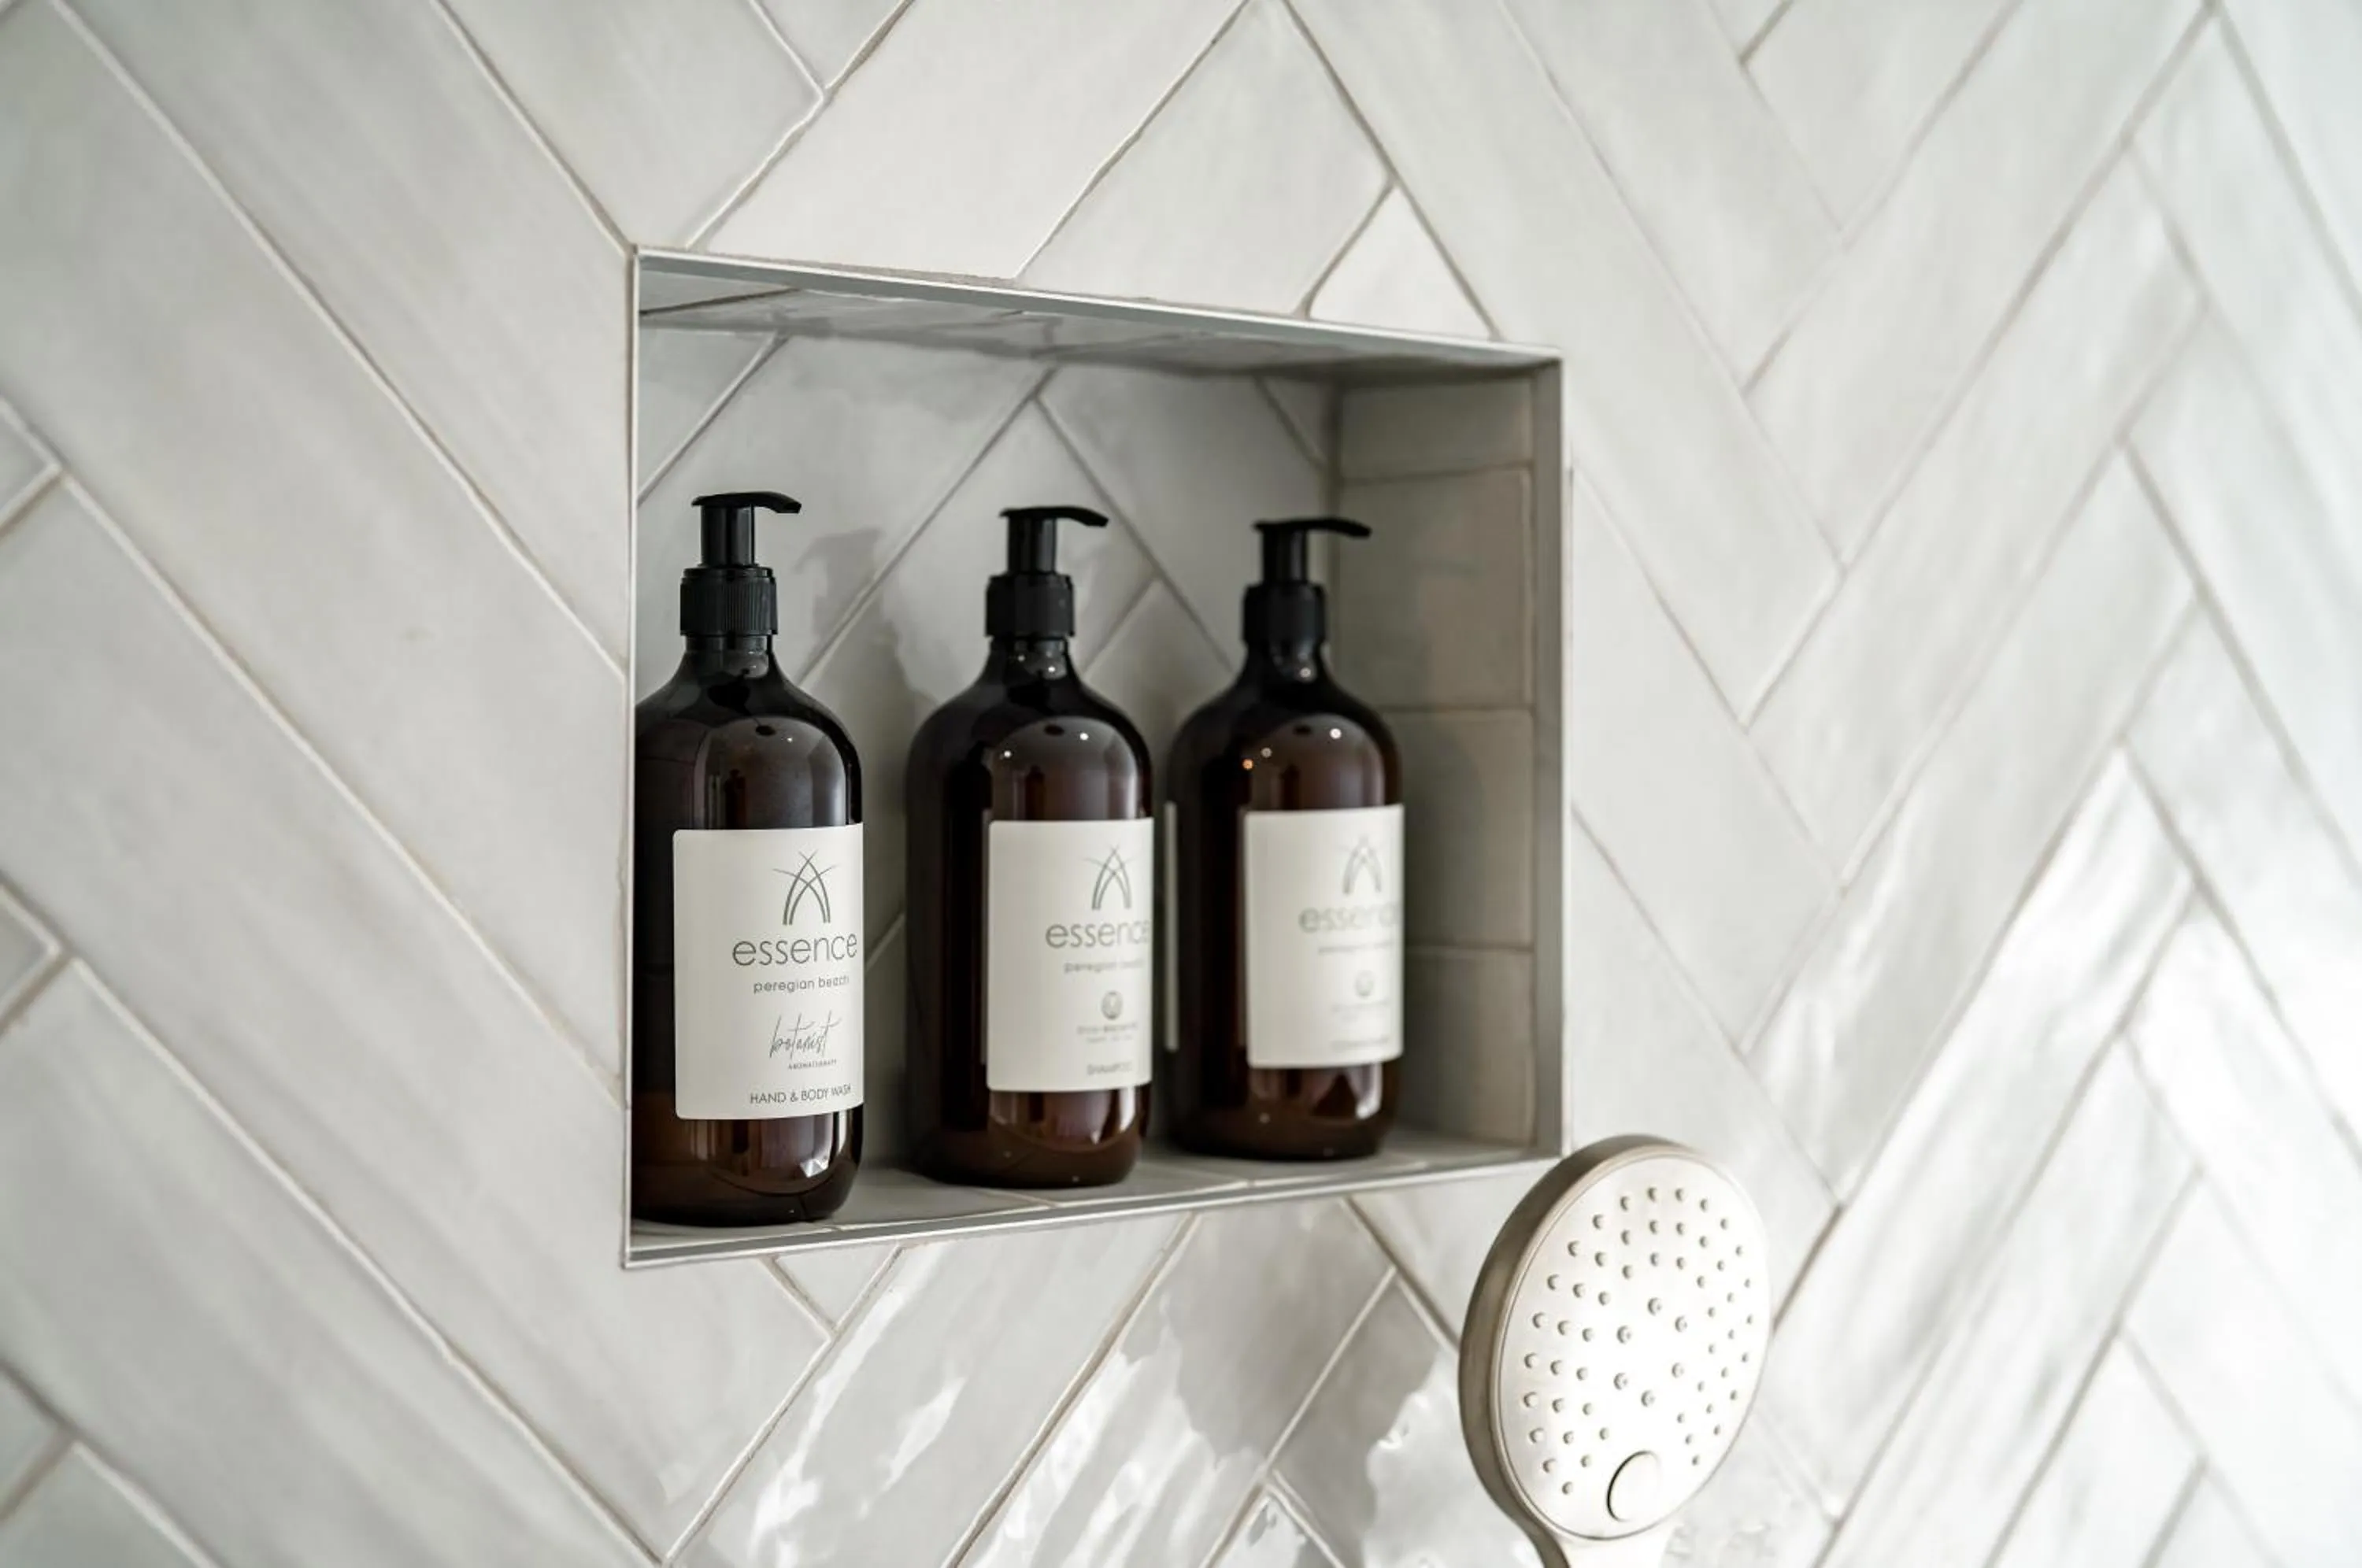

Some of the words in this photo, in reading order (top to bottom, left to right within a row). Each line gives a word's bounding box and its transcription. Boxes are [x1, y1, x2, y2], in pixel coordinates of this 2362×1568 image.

[732, 933, 857, 966] essence
[753, 978, 815, 996] peregian
[817, 974, 850, 989] beach
[750, 1091, 787, 1104] HAND
[790, 1089, 799, 1103] &
[801, 1088, 829, 1101] BODY
[831, 1082, 851, 1097] WASH
